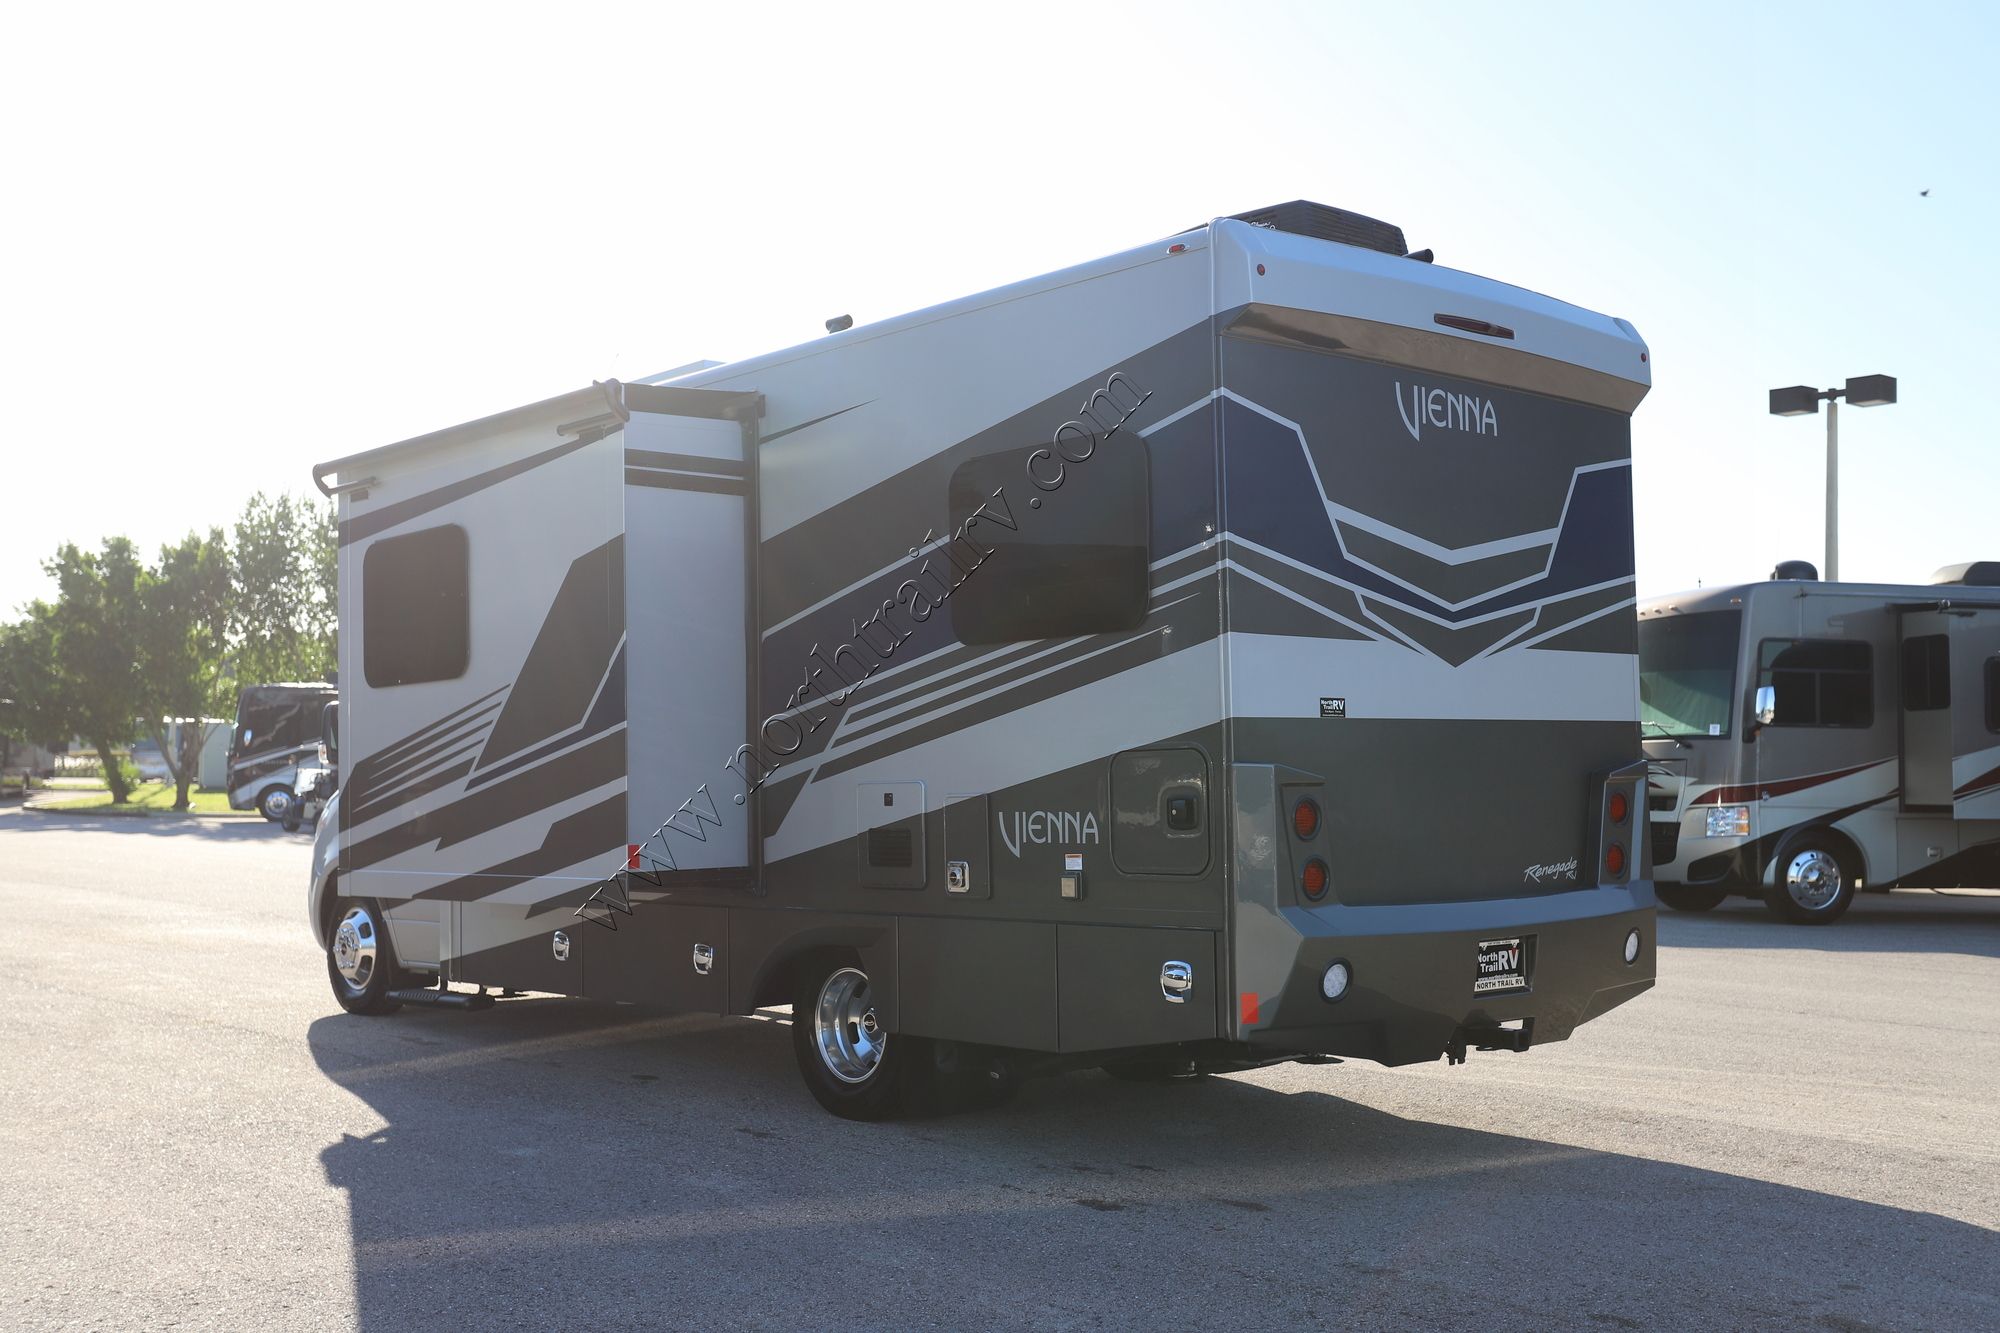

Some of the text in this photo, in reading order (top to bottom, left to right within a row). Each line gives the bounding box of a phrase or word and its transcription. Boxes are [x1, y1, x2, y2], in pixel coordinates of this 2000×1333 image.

[1395, 381, 1498, 441] VIENNA
[1333, 700, 1345, 710] RV
[998, 810, 1099, 858] VIENNA
[1523, 856, 1578, 883] Renegade
[1565, 870, 1578, 880] RV
[1478, 949, 1519, 971] North RV
[1480, 962, 1498, 972] Trail
[1476, 978, 1524, 990] NORTH TRAIL RV
